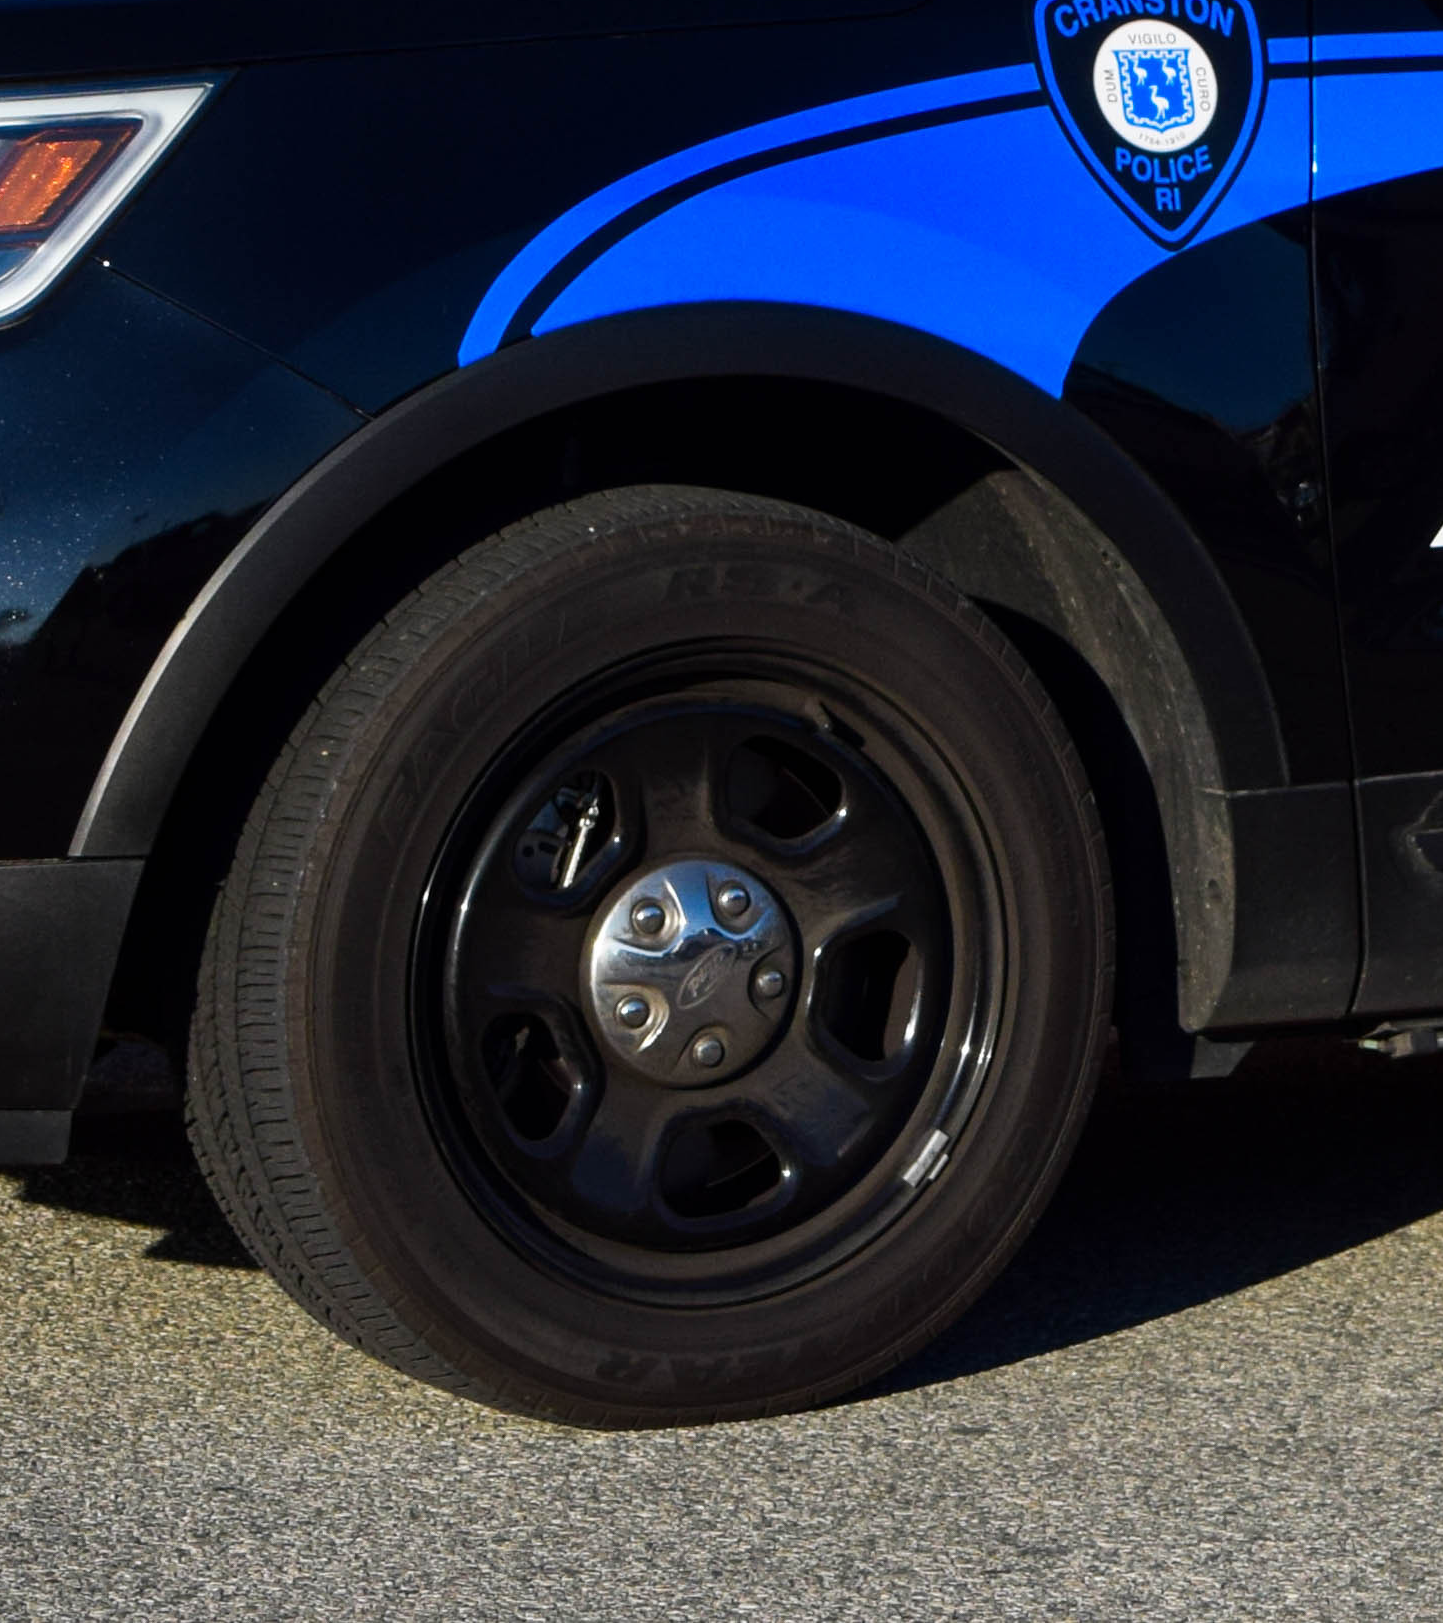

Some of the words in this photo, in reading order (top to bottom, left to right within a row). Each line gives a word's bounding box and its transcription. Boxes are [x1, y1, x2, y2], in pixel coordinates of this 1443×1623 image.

[1104, 68, 1118, 104] DUM
[1127, 32, 1177, 45] VIGILO
[1195, 66, 1212, 113] CURO
[1115, 144, 1213, 185] POLICE
[1155, 187, 1181, 212] RI
